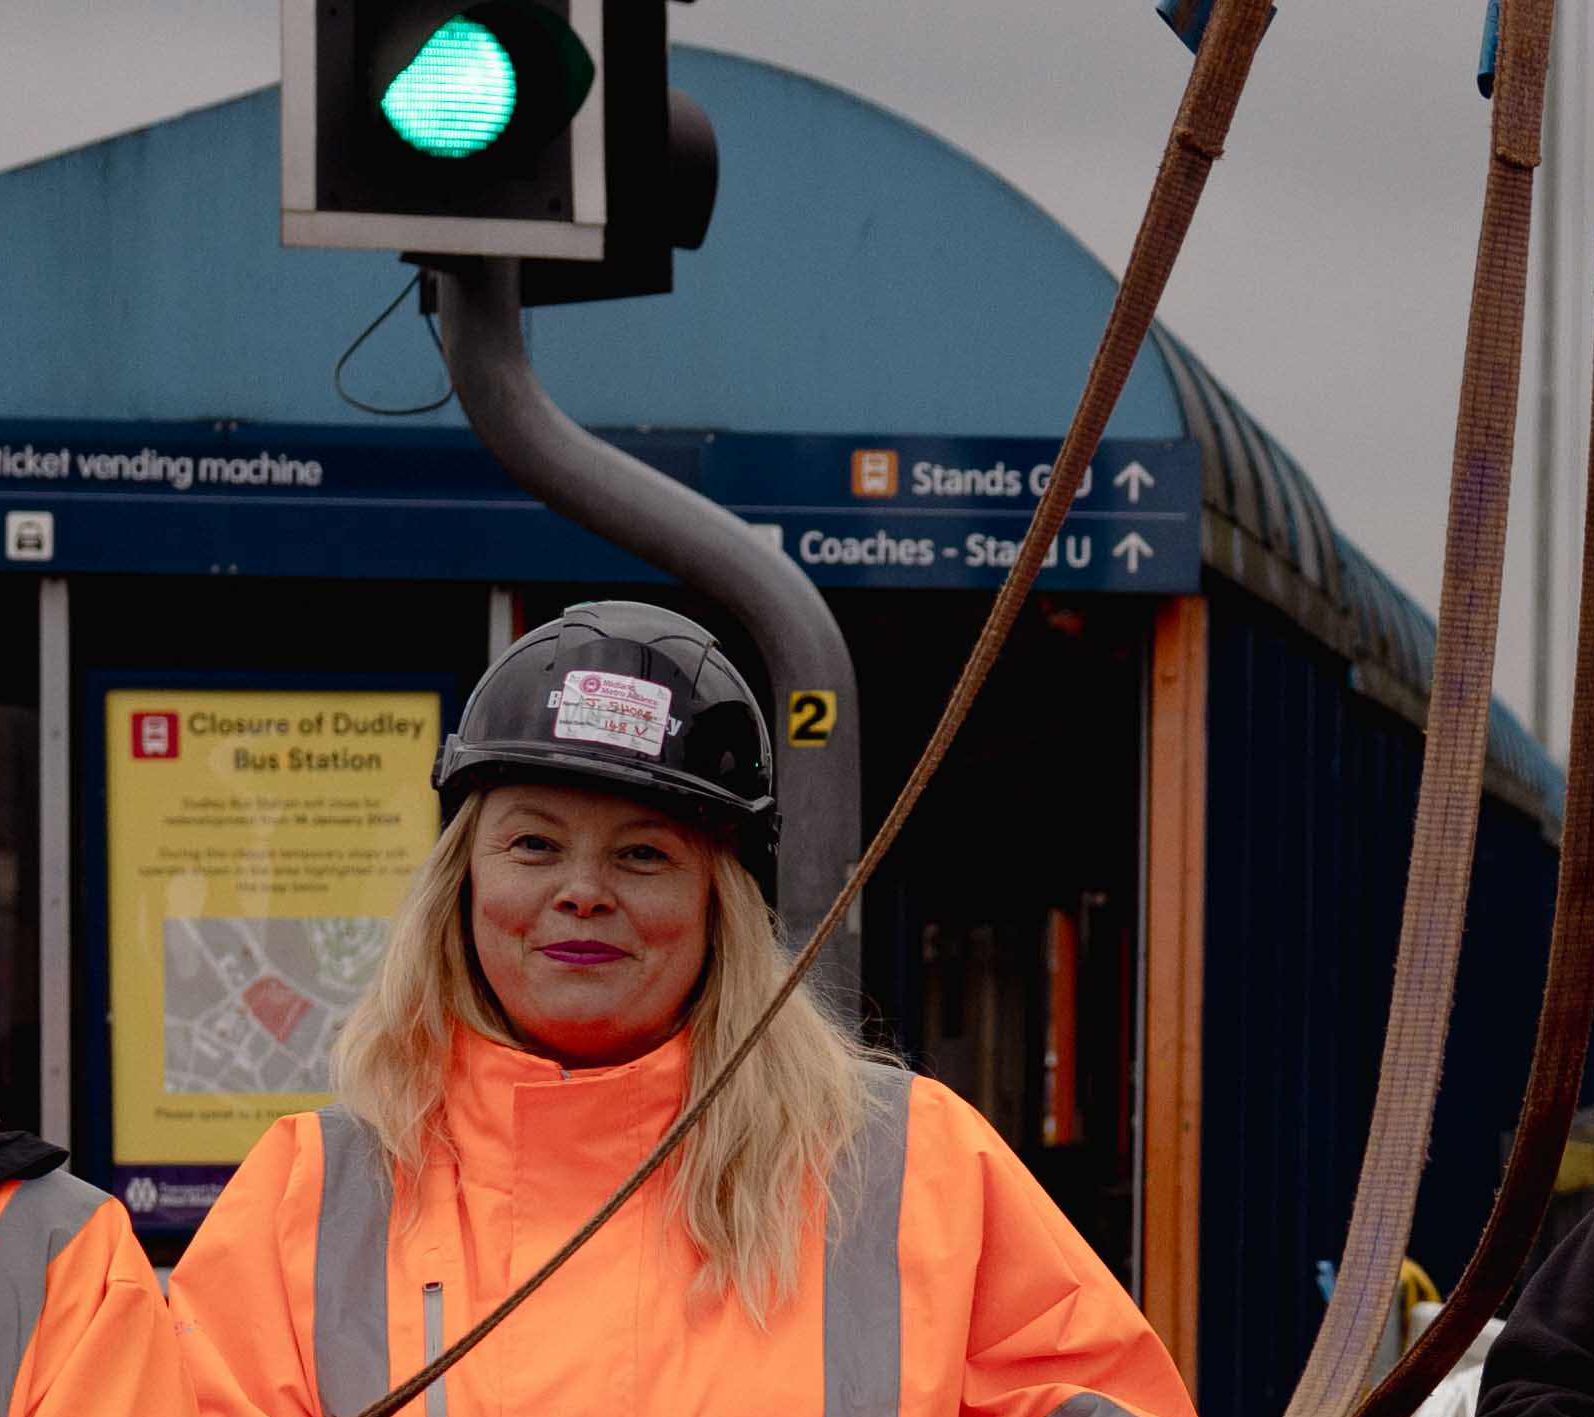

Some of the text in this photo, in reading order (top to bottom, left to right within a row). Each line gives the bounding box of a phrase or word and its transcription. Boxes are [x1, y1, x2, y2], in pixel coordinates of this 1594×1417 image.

[78, 448, 194, 490] vending
[197, 452, 324, 486] machine
[911, 461, 1022, 496] Stands
[799, 530, 935, 566] Coaches
[1064, 535, 1092, 569] U
[187, 711, 426, 740] Closure of Dudley
[794, 696, 827, 740] 2
[234, 748, 383, 772] Bus Station
